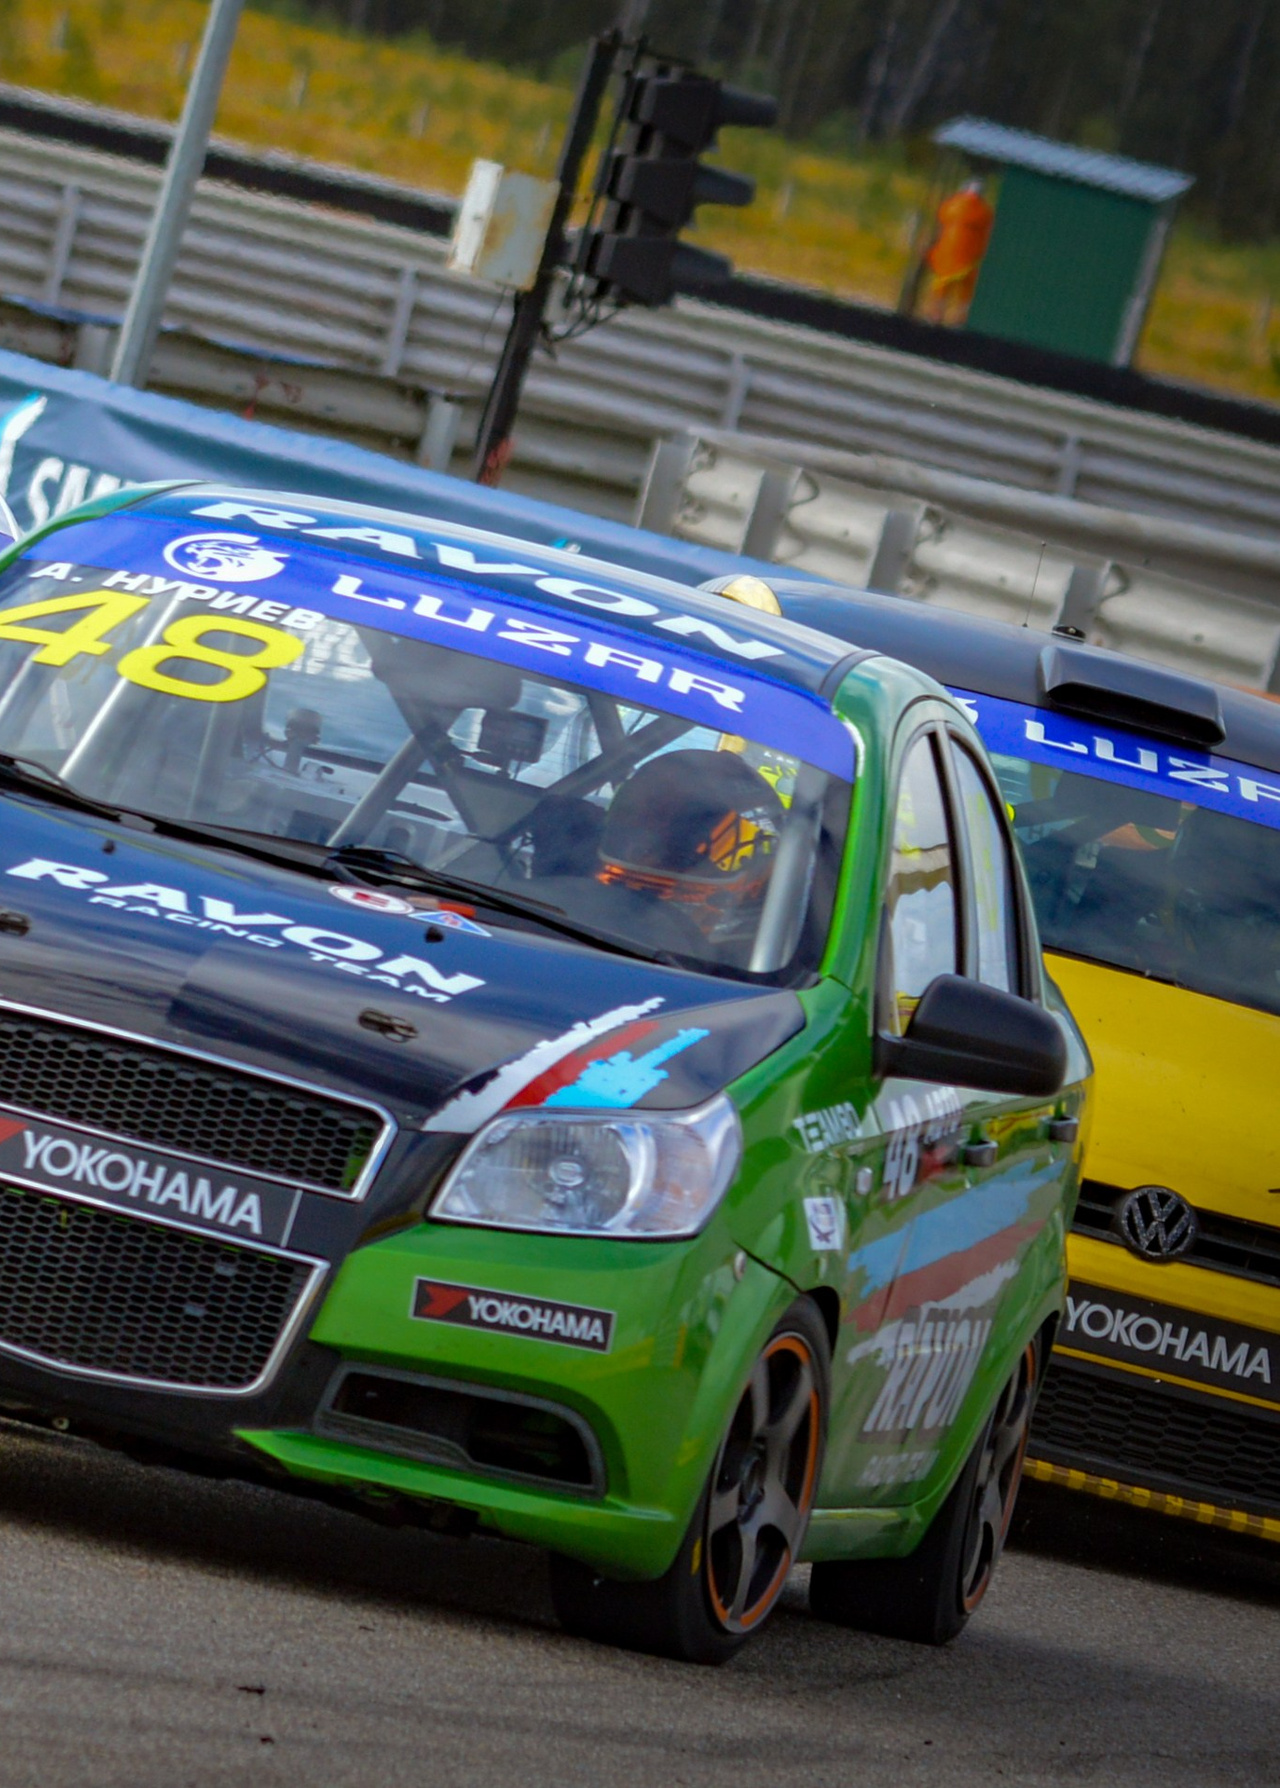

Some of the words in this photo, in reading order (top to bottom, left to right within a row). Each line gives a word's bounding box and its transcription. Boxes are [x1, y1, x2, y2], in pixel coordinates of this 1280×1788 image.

[103, 571, 327, 631] НУРИЕВ
[190, 501, 785, 660] RAVON
[331, 573, 746, 712] LUZAR
[5, 858, 487, 995] RAVON
[88, 896, 284, 948] RACING
[307, 951, 453, 1004] TEAM
[22, 1129, 263, 1236] YOKOHAMA
[467, 1294, 605, 1343] YOKOHAMA
[1066, 1296, 1272, 1384] YOKOHAMA
